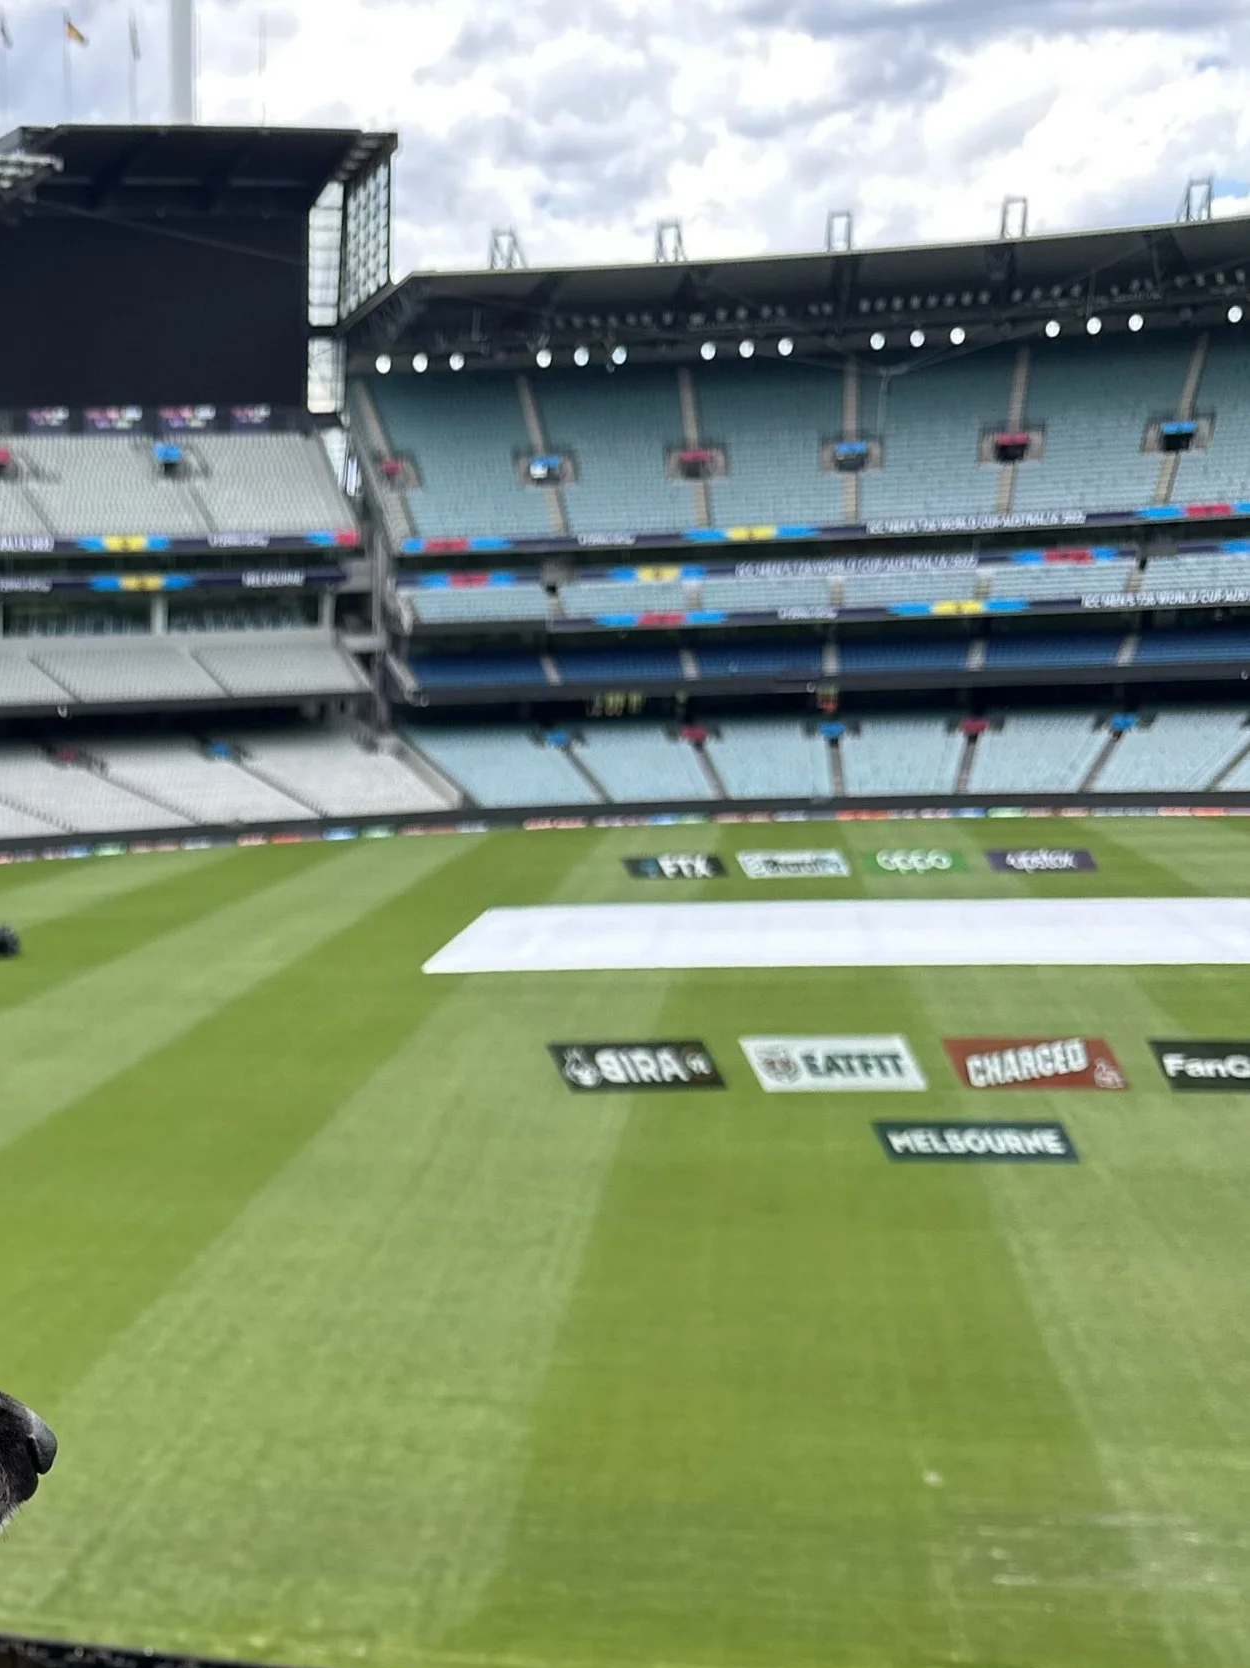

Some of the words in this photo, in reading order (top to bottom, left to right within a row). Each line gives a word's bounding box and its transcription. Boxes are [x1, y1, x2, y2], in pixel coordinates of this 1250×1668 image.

[876, 849, 952, 874] oppo
[595, 1047, 689, 1083] BIRA
[800, 1053, 911, 1078] EATFIT
[964, 1036, 1090, 1088] CHARGED
[886, 1127, 1066, 1155] MELBOURNE
